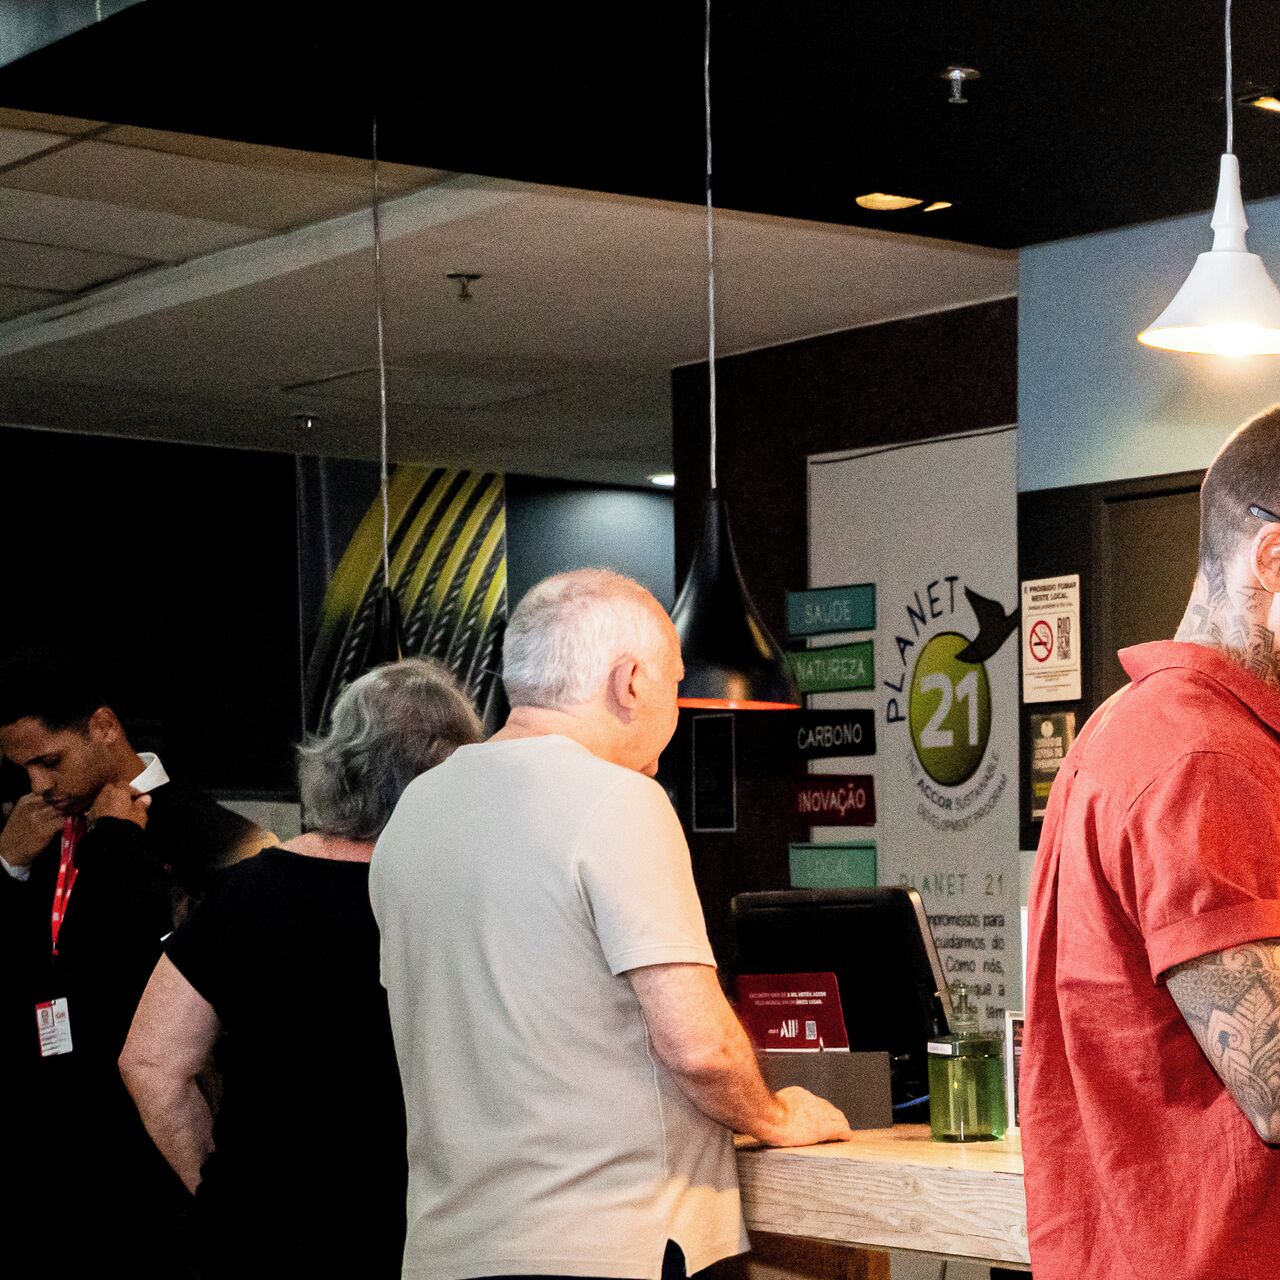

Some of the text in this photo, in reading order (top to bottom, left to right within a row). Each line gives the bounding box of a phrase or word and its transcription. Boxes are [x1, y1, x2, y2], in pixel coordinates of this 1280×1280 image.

[884, 575, 959, 723] PLANET
[920, 671, 979, 748] 21
[798, 724, 863, 749] CARBONO
[798, 783, 866, 816] INOVAÇÃO
[984, 873, 1003, 896] 21
[945, 954, 976, 972] Como
